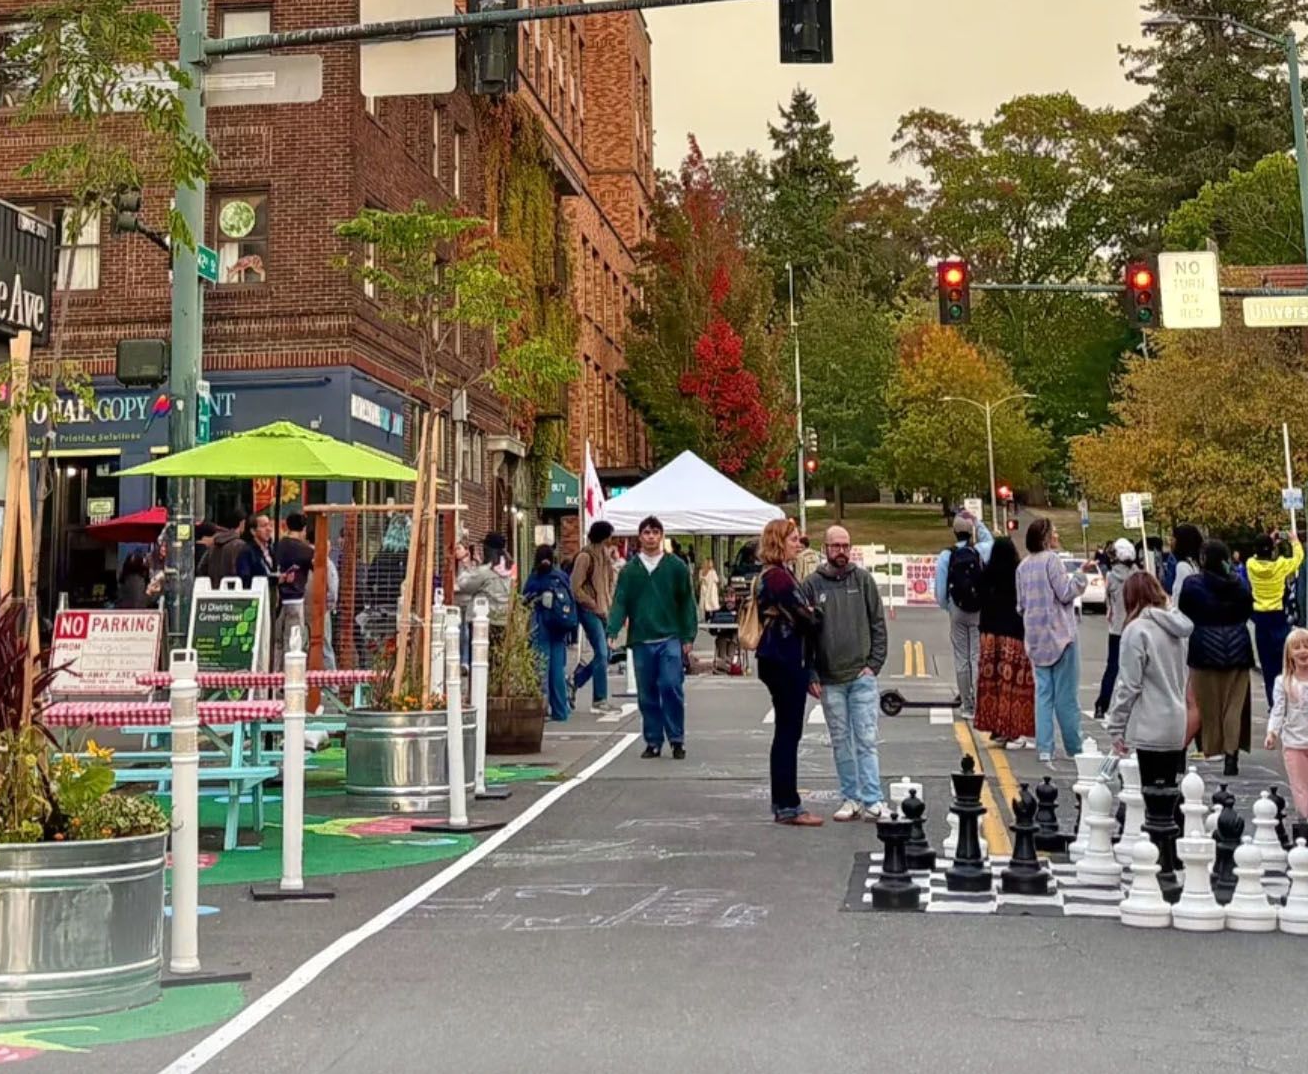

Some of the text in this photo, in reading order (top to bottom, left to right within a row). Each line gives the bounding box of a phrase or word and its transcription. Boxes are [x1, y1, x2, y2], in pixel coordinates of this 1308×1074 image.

[1174, 261, 1200, 275] NO
[8, 273, 45, 332] Ave
[97, 396, 150, 422] COPY
[207, 603, 233, 611] District
[60, 616, 155, 636] NO PARKING
[198, 613, 243, 622] Green Street
